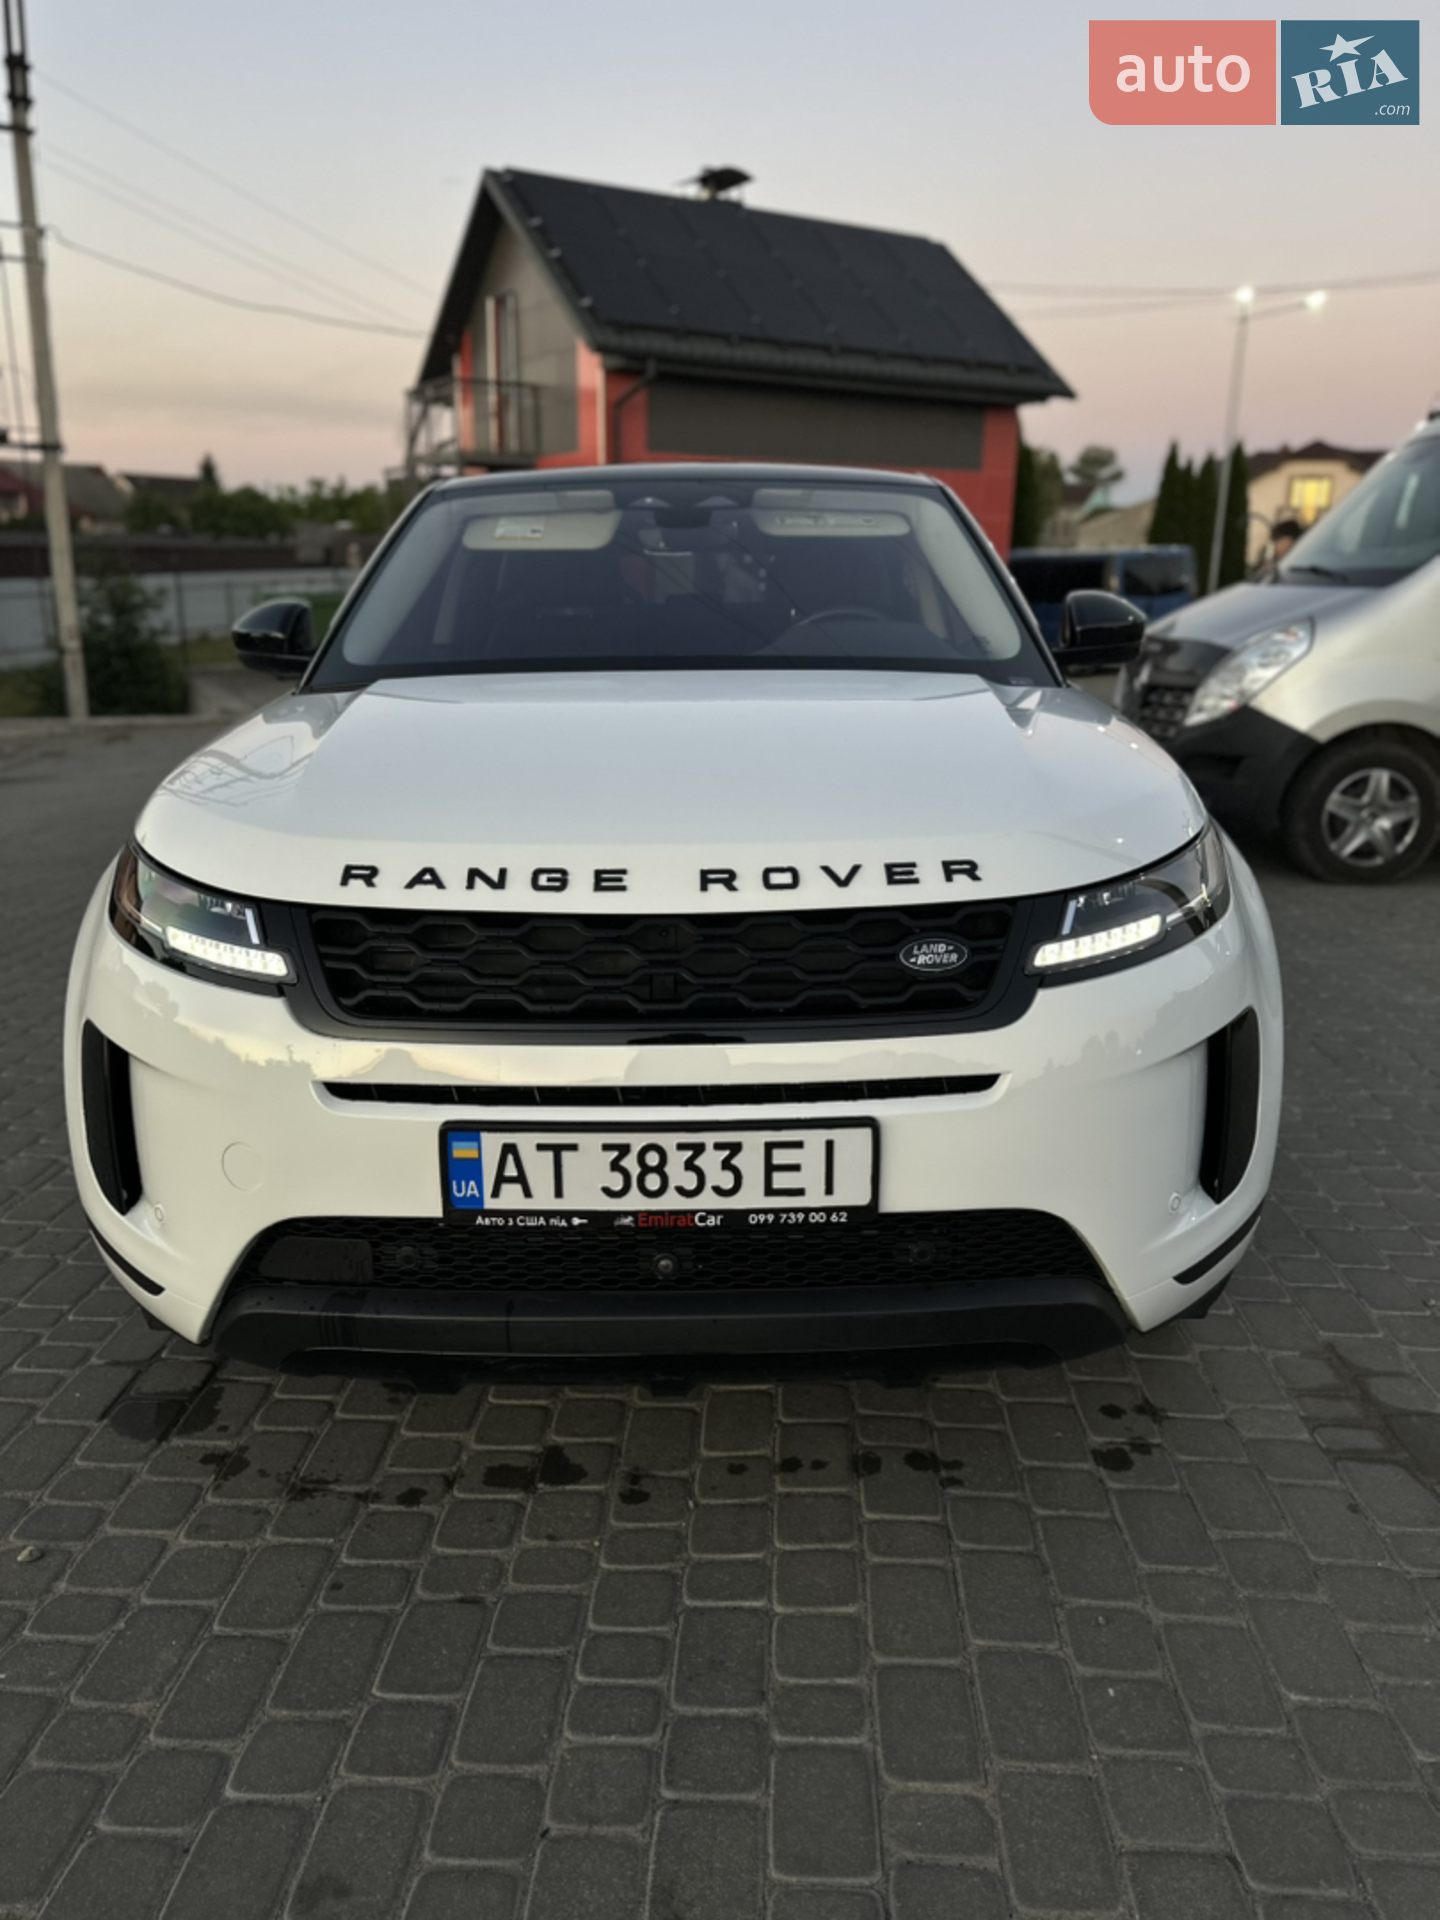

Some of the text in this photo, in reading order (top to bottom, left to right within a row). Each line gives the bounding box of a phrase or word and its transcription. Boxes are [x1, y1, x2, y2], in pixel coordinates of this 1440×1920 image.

[340, 859, 983, 893] RANGE ROVER
[600, 1141, 743, 1199] 3833
[452, 1180, 480, 1198] UA
[476, 1215, 505, 1226] Авто
[516, 1216, 546, 1226] США
[637, 1212, 724, 1227] EmiratCar
[748, 1211, 848, 1225] 099 739 00 62
